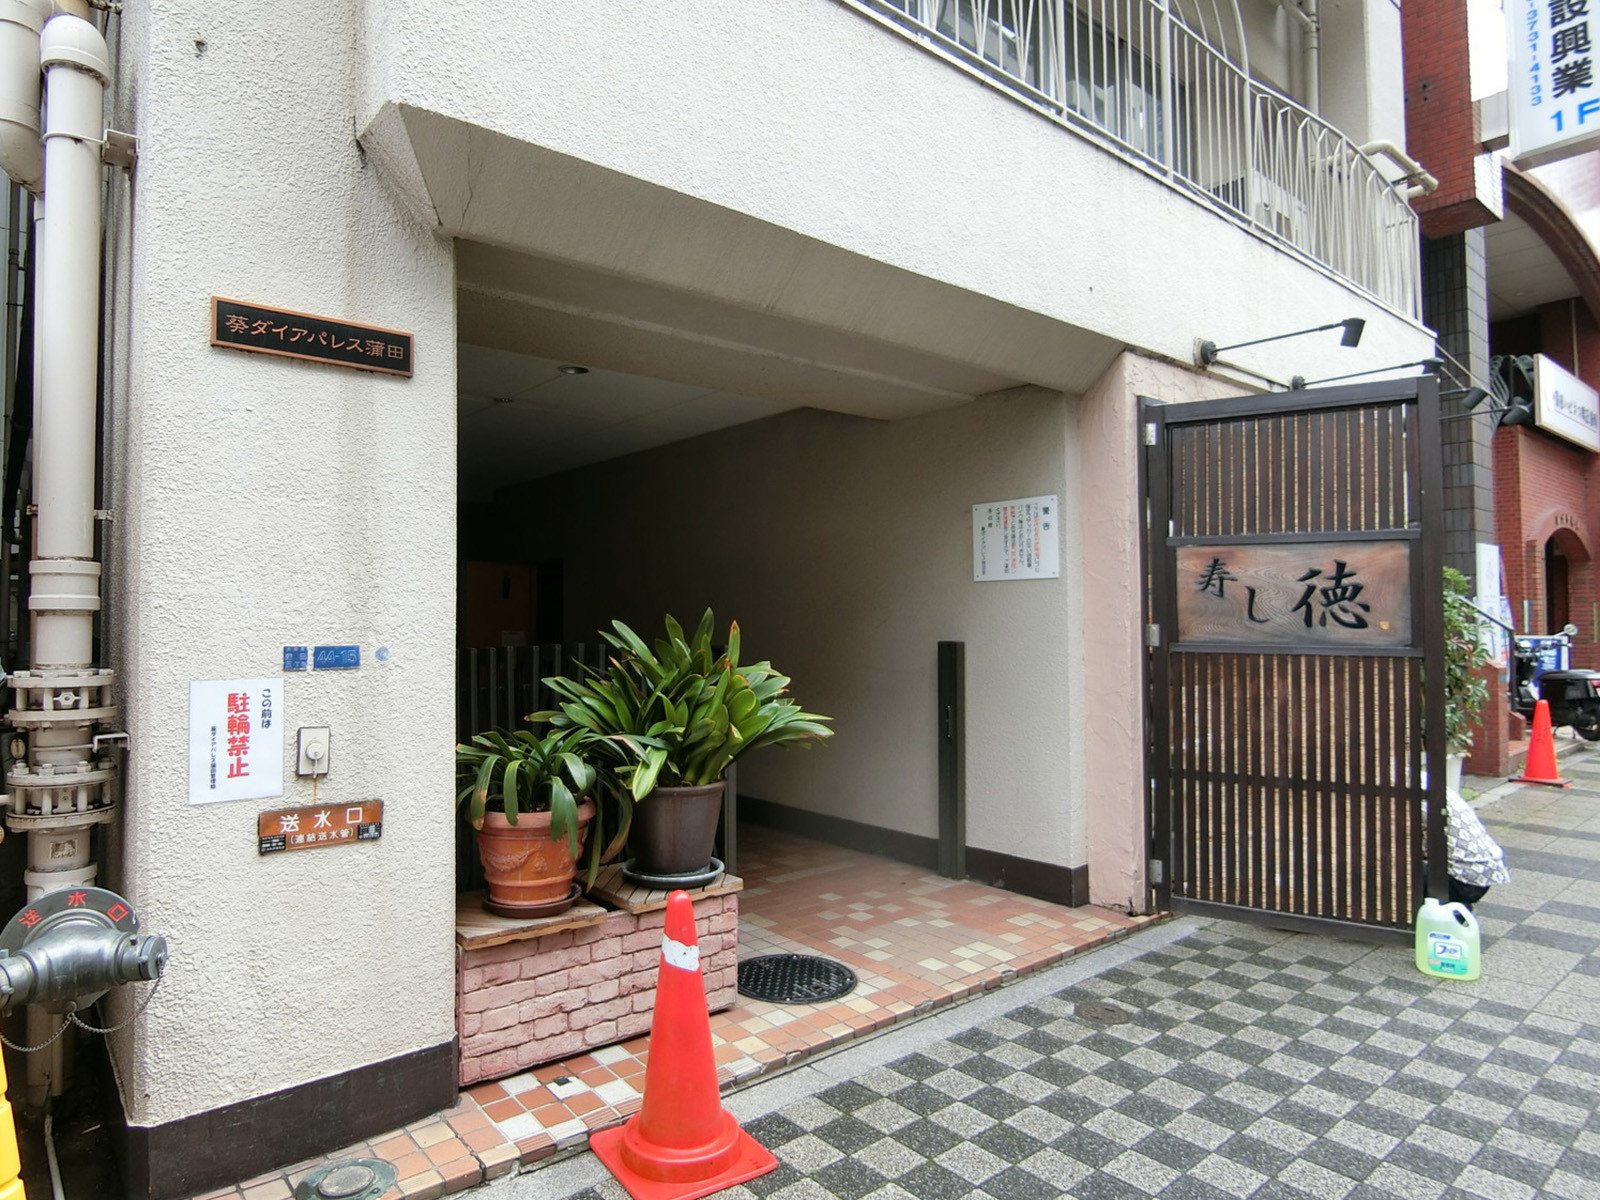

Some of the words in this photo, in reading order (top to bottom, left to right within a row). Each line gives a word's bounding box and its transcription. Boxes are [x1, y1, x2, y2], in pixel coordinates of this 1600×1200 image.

[1526, 0, 1542, 106] -3731-4133
[1550, 98, 1600, 132] 1F
[225, 313, 404, 360] 葵ダイアパレス蒲田
[317, 649, 357, 664] 44-15
[261, 688, 272, 728] この前は
[227, 692, 250, 779] 駐輪禁止
[280, 806, 363, 833] 送水口
[18, 890, 129, 928] 送水口
